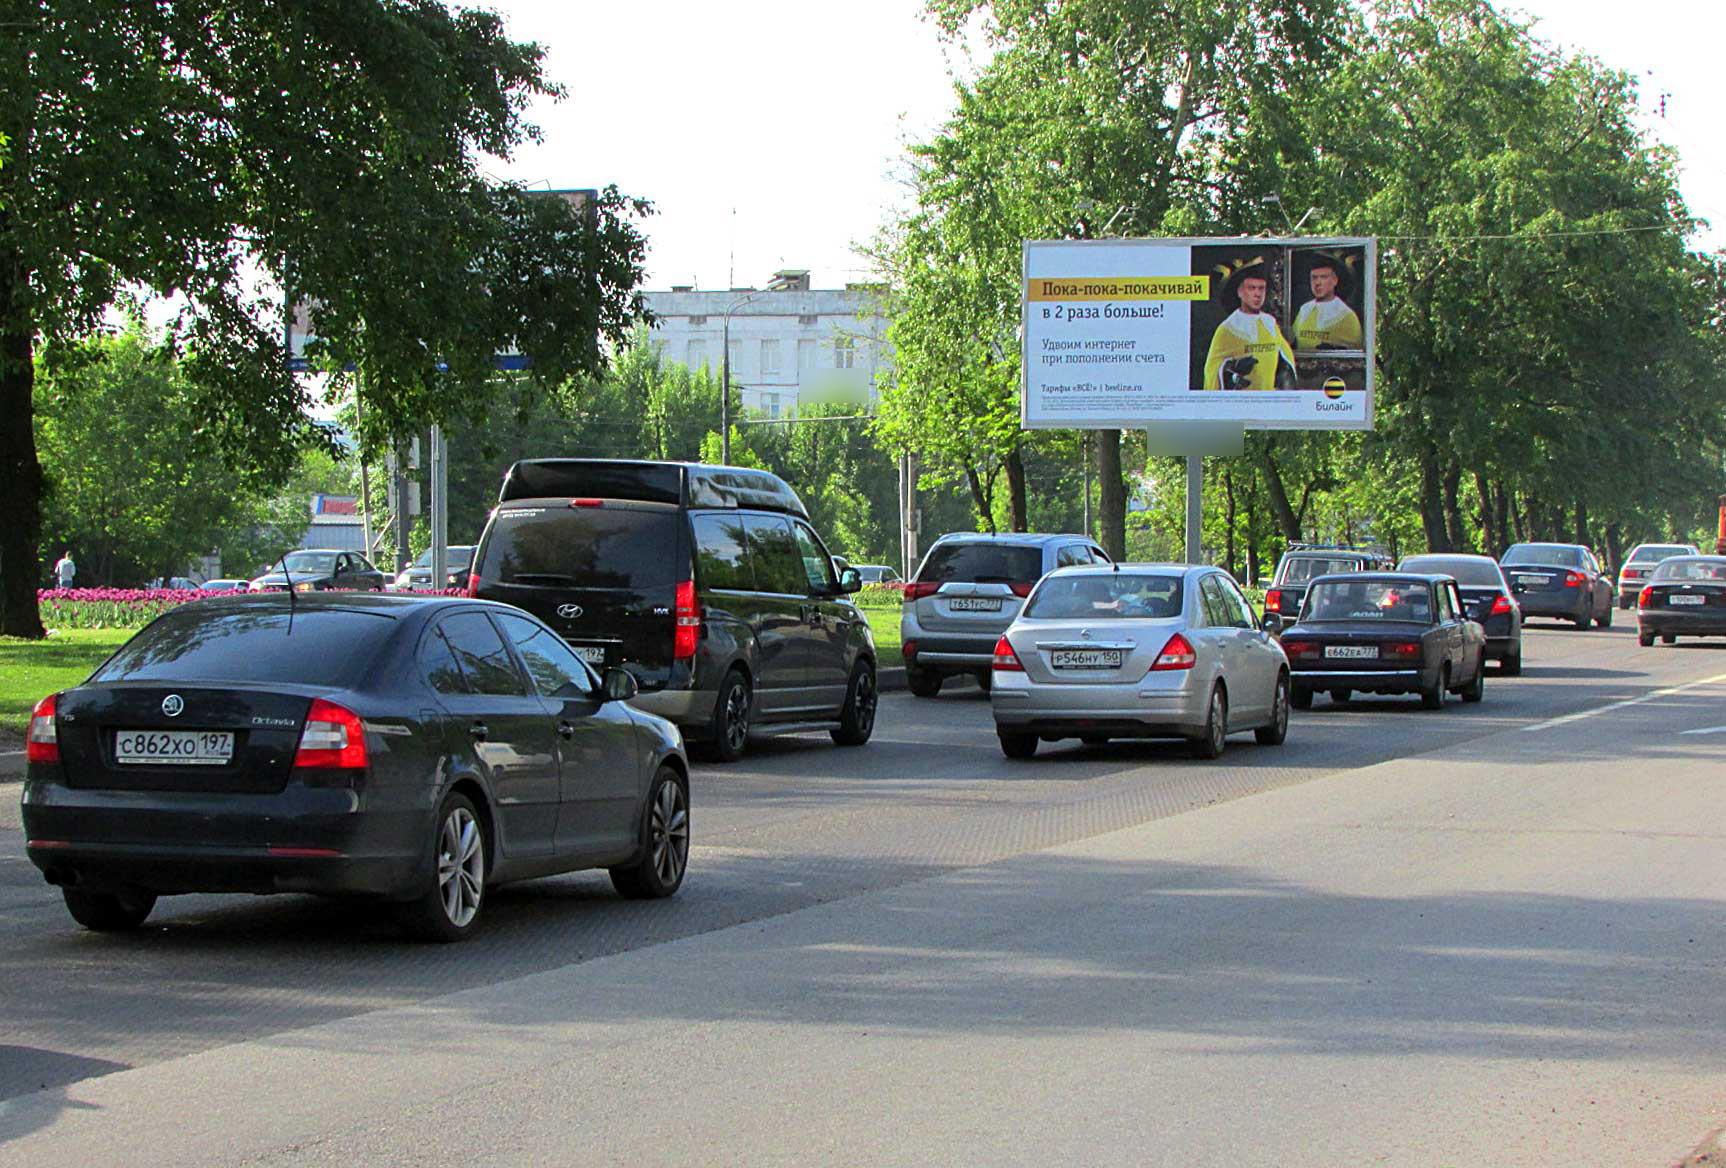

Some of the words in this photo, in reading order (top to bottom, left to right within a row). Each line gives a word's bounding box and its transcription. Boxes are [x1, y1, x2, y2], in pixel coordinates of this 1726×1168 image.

[1042, 281, 1203, 296] Пока-пока-покачивай
[1043, 308, 1050, 319] в
[1055, 305, 1063, 319] 2
[1067, 307, 1100, 322] раза
[1104, 304, 1164, 319] больше!
[1042, 338, 1082, 352] Удвоим
[1085, 340, 1136, 352] интернет
[1042, 355, 1063, 366] при
[1066, 353, 1132, 364] пополнении
[1135, 353, 1165, 364] счета
[1041, 384, 1071, 394] Тарифы
[1105, 384, 1142, 392] beeline.ru
[1315, 401, 1353, 411] Билайн
[252, 717, 296, 726] Octavia
[121, 734, 196, 755] С862ХО
[200, 733, 228, 750] 197
